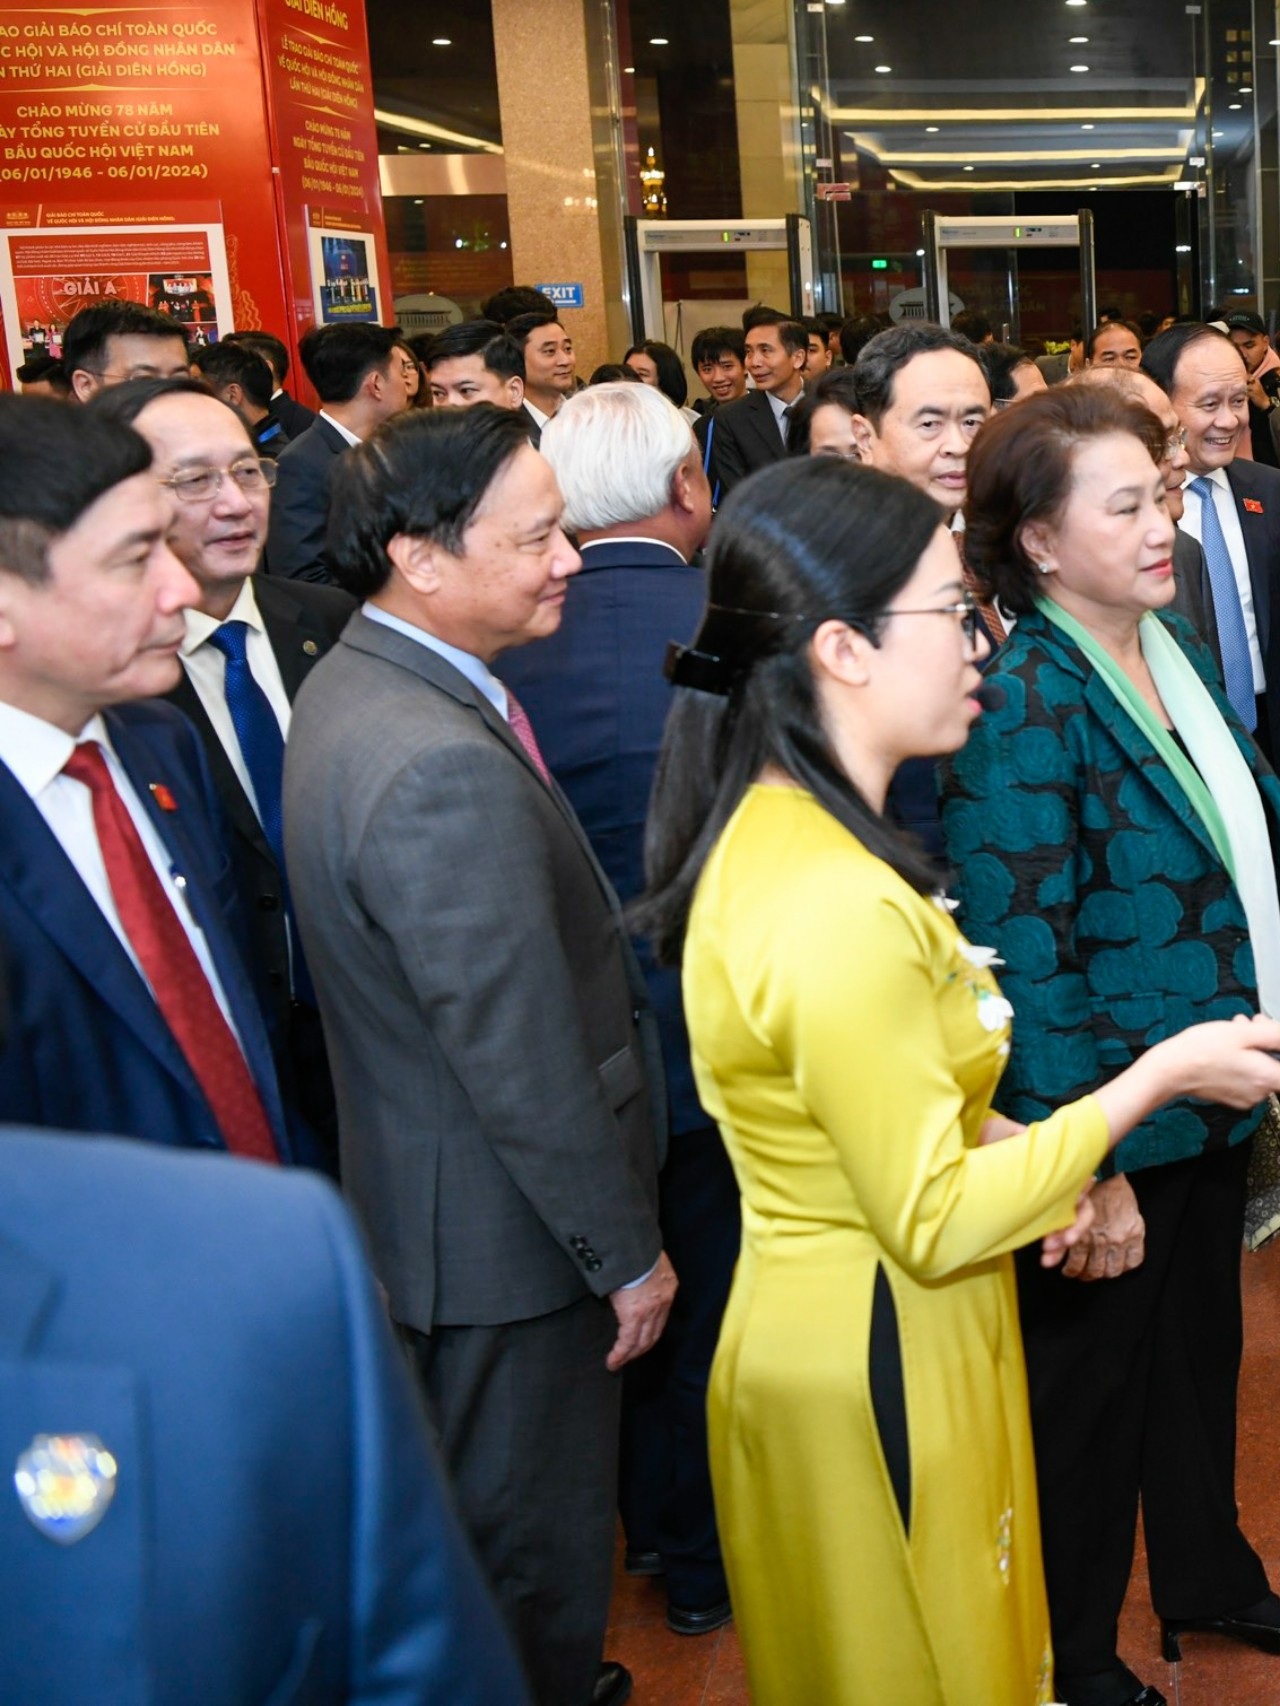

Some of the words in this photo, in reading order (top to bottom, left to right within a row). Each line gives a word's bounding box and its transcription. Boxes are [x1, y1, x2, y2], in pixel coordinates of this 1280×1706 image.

[23, 21, 55, 37] GIẢI
[59, 22, 92, 37] BÁO
[95, 21, 123, 36] CHÍ
[125, 20, 168, 36] TOÀN
[172, 19, 217, 37] QUỐC
[15, 42, 43, 60] HỘI
[46, 42, 68, 57] VÀ
[71, 42, 100, 60] HỘI
[103, 40, 150, 56] ĐỒNG
[153, 40, 199, 56] NHÂN
[202, 40, 236, 56] DÂN
[9, 62, 42, 78] THỨ
[45, 65, 72, 77] HAI
[76, 60, 112, 78] (GIẢI
[115, 61, 153, 76] DIÊN
[156, 60, 208, 77] HỒNG)
[16, 102, 62, 118] CHÀO
[65, 101, 113, 117] MỪNG
[116, 104, 134, 116] 78
[137, 101, 173, 116] NĂM
[20, 120, 65, 138] TỔNG
[68, 119, 120, 137] TUYỂN
[123, 121, 146, 137] CỬ
[148, 119, 181, 137] ĐẦU
[184, 121, 220, 136] TIÊN
[4, 142, 37, 160] BẦU
[40, 141, 86, 159] QUỐC
[89, 142, 117, 161] HỘI
[120, 142, 155, 161] VIỆT
[158, 144, 194, 157] NAM
[107, 162, 208, 180] 06/01/2024)
[64, 277, 100, 296] GIẢI
[104, 280, 118, 295] A
[542, 287, 576, 299] EXIT
